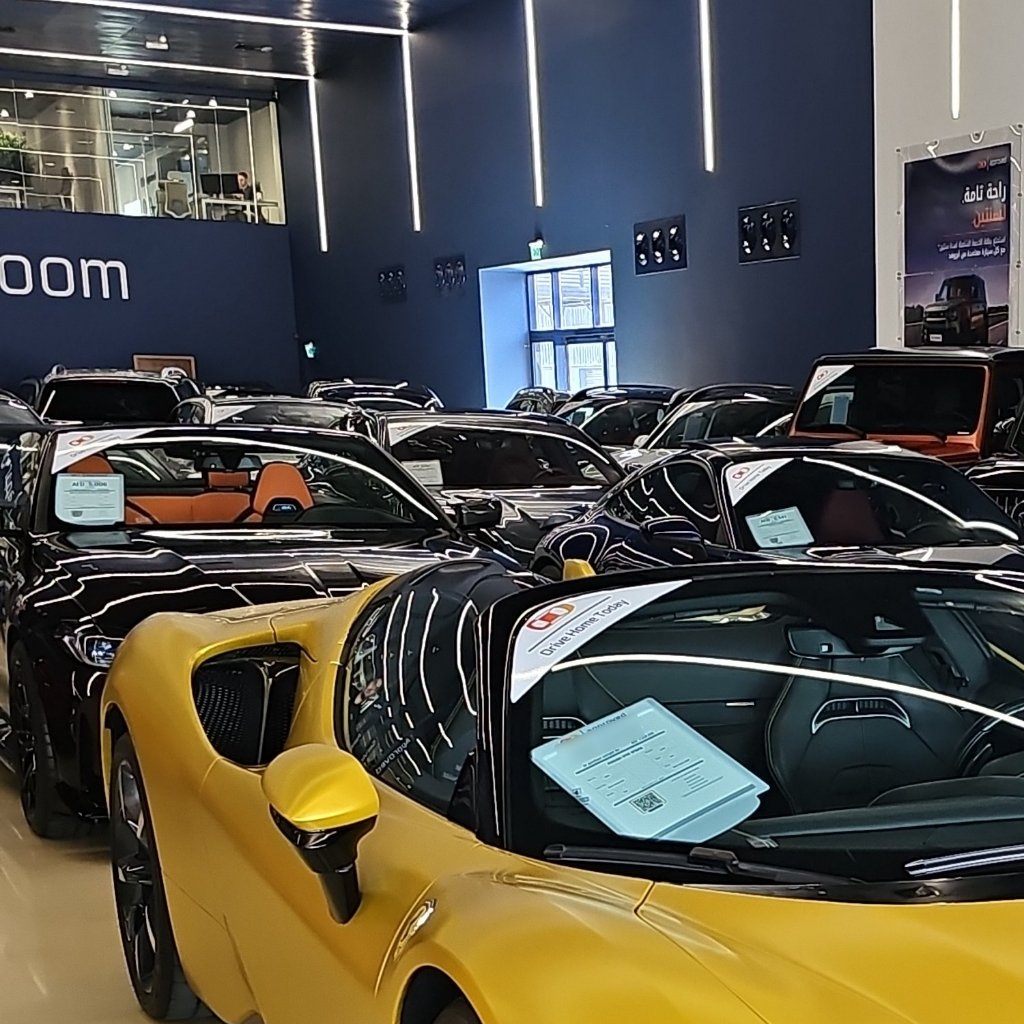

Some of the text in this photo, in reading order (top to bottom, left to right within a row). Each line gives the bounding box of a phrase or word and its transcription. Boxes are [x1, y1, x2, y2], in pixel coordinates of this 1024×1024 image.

[962, 181, 1006, 204] راحة تامة.
[540, 599, 630, 656] Drive Home Today
